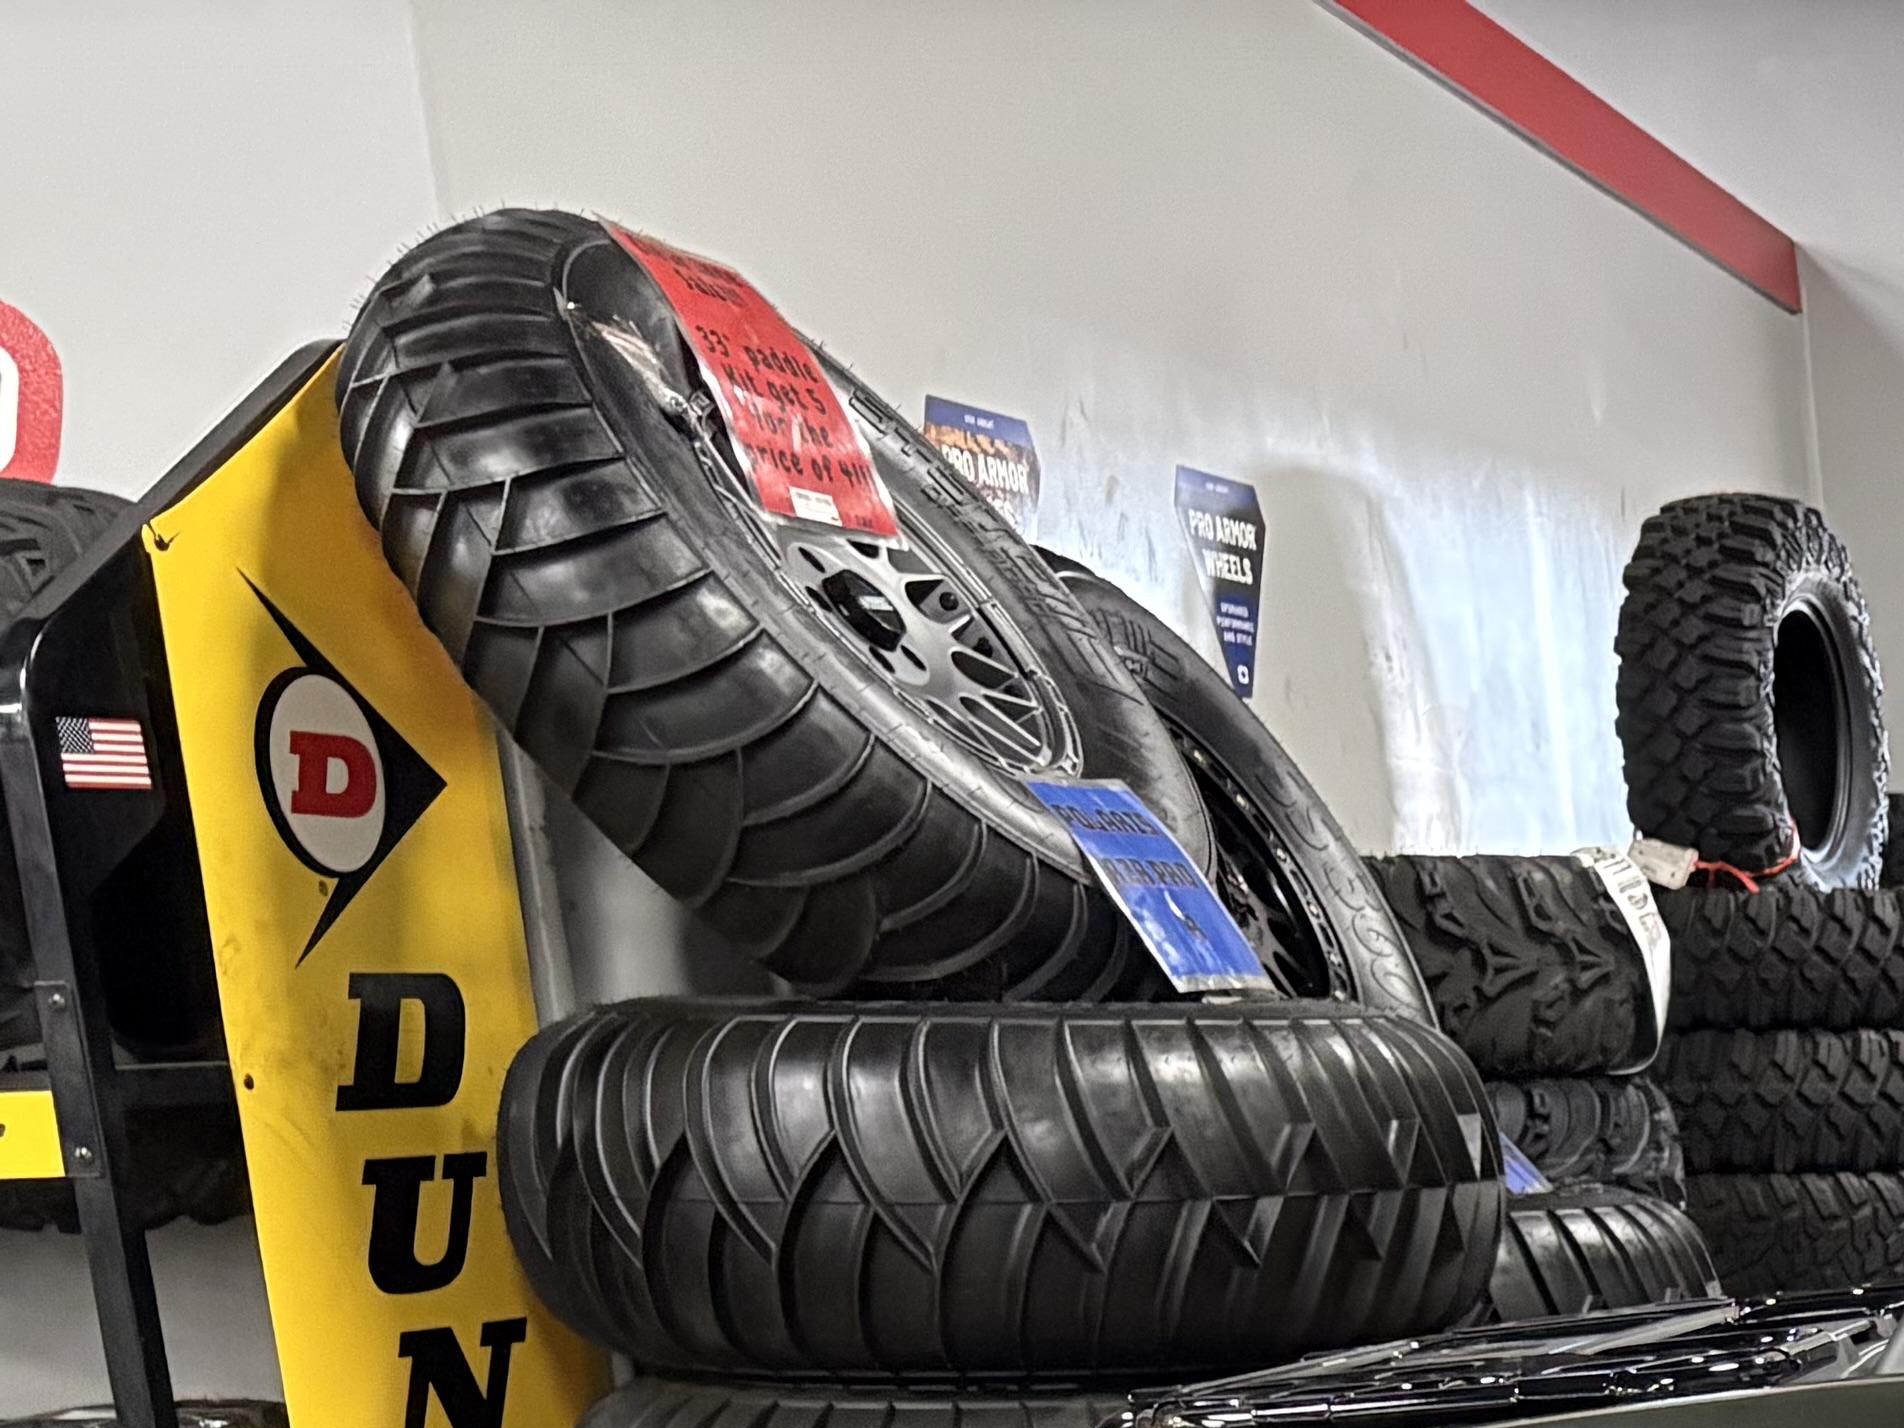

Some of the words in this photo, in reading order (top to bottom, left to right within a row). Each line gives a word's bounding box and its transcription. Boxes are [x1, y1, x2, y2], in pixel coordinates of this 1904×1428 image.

[745, 345, 819, 384] paddle
[767, 375, 808, 412] get
[806, 388, 827, 416] 5
[811, 455, 834, 484] of
[977, 454, 1029, 494] ARMOR
[1188, 509, 1214, 540] PRO
[1215, 516, 1257, 551] ARMOR
[1203, 548, 1254, 585] WHEELS
[289, 730, 377, 819] D
[1050, 804, 1162, 836] POLARIS
[1146, 859, 1200, 888] PRO
